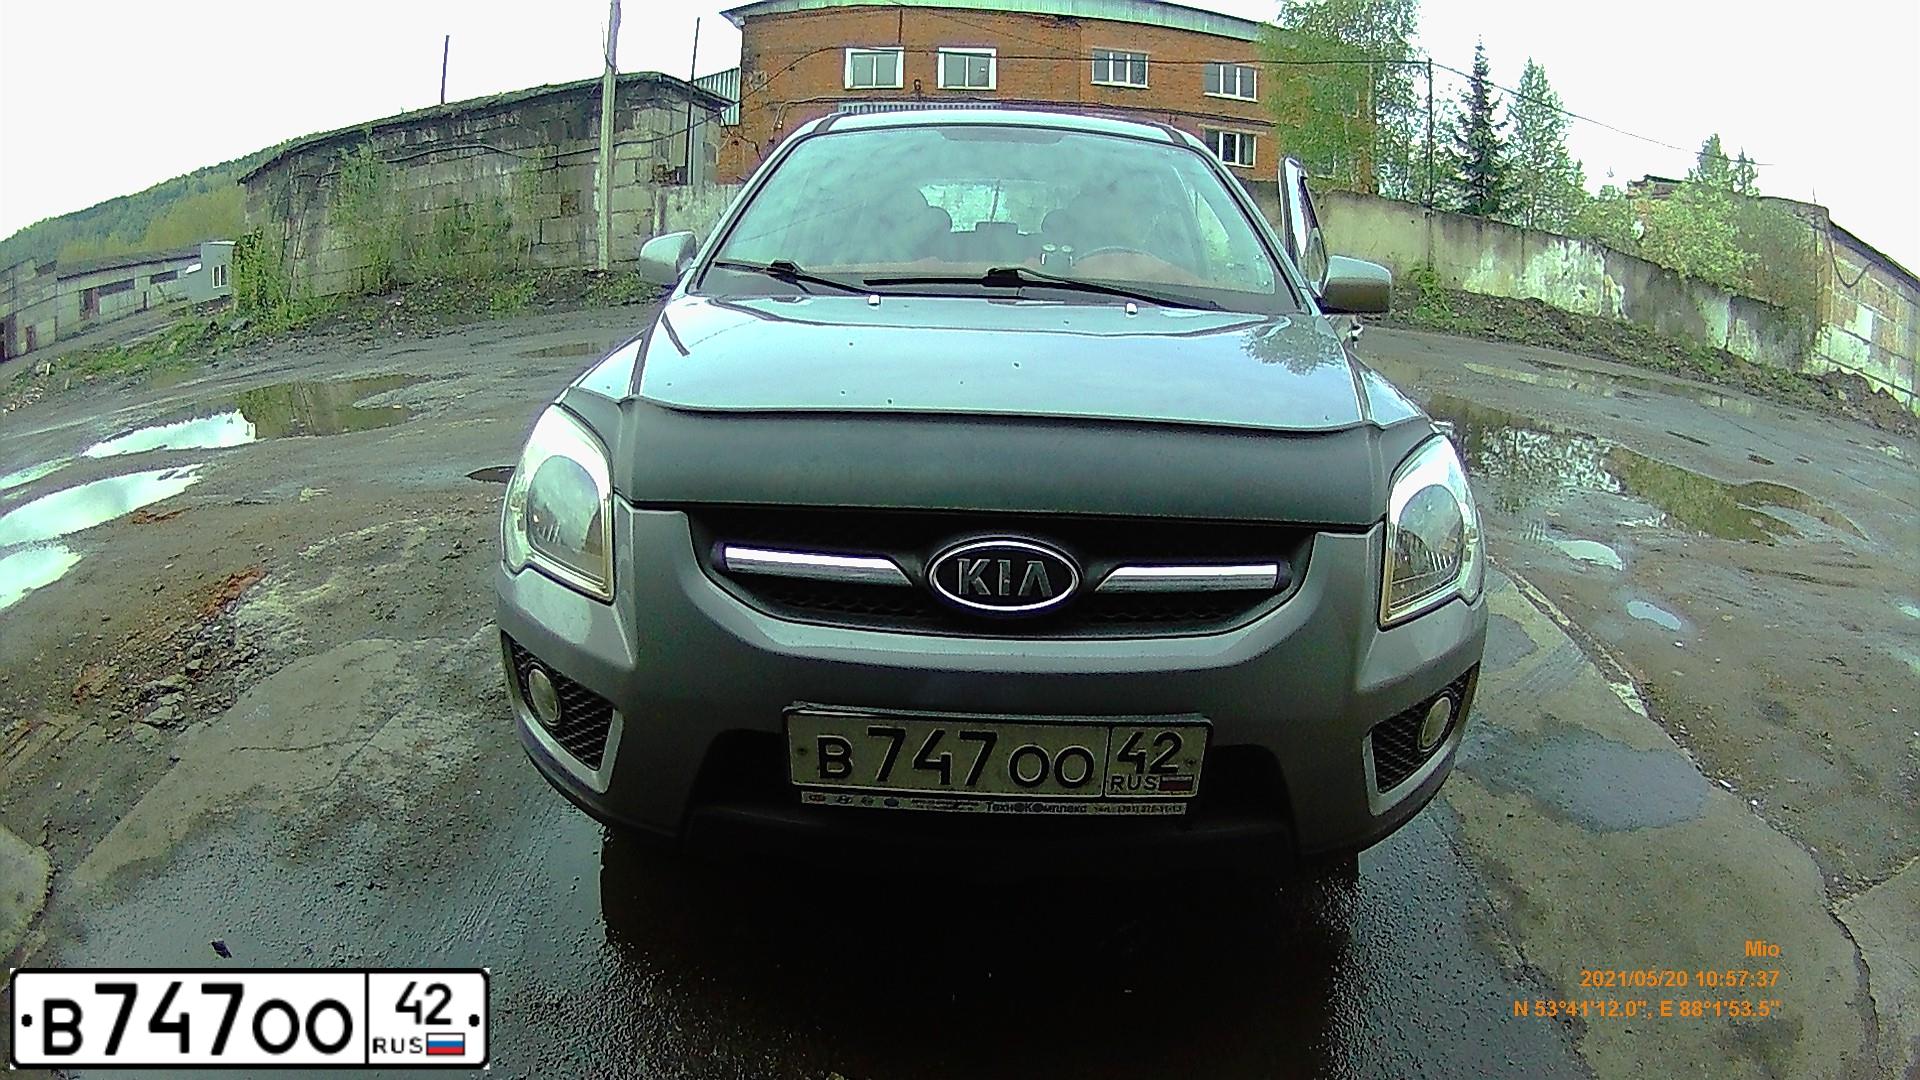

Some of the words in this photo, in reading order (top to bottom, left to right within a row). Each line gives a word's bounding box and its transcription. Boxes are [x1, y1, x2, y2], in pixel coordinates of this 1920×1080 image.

[956, 557, 1053, 597] KIA
[1115, 730, 1183, 775] 42
[1109, 776, 1158, 792] RUS
